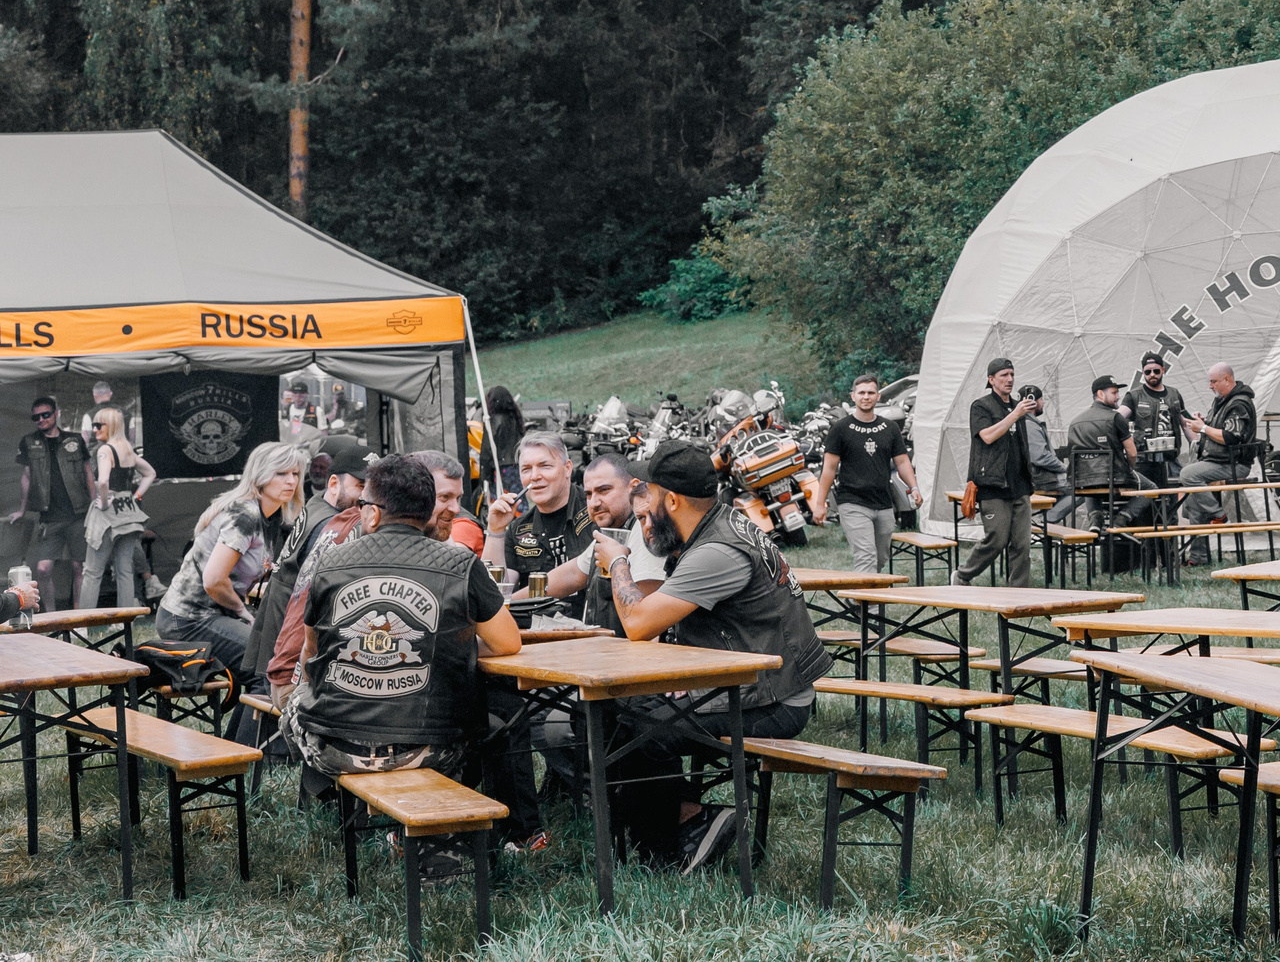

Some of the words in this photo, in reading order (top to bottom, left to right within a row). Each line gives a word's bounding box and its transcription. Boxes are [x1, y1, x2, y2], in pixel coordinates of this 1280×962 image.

[200, 312, 323, 340] RUSSIA
[187, 410, 234, 426] HARLEY
[849, 422, 888, 434] SUPPORT
[340, 584, 371, 610] FREE
[379, 582, 433, 616] CHAPTER
[340, 669, 384, 690] MOSCOW
[387, 673, 423, 691] RUSSIA
